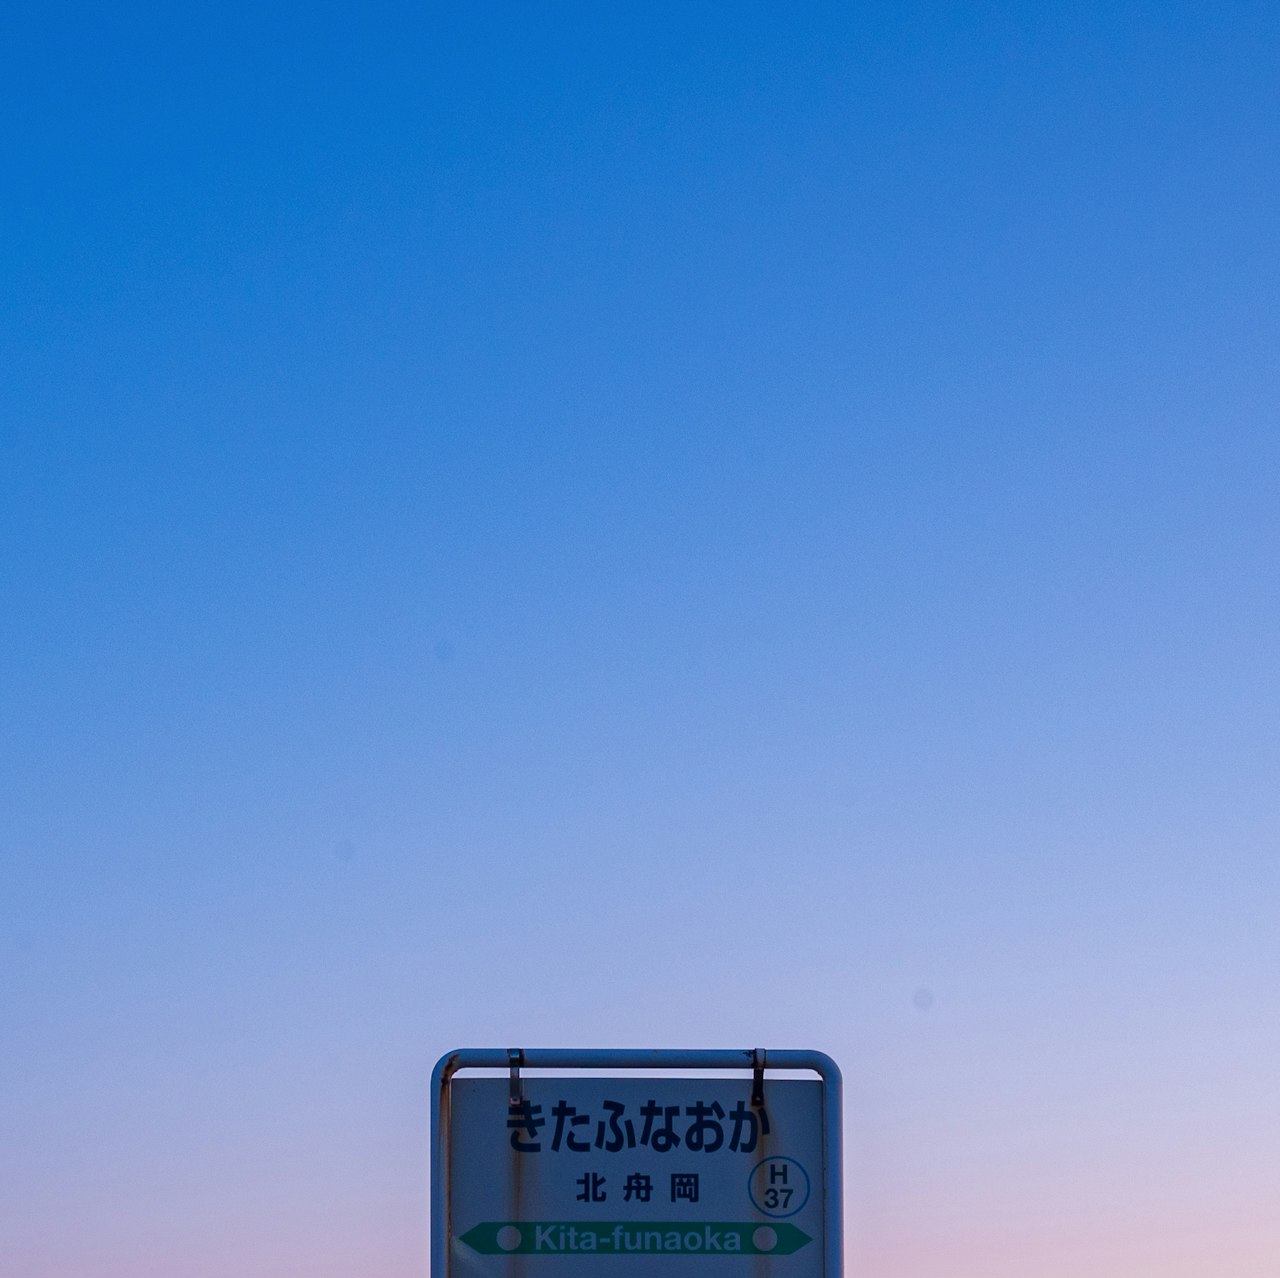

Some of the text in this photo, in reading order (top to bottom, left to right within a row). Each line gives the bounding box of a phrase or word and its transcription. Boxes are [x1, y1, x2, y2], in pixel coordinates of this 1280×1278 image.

[507, 1100, 770, 1152] きたふなおか
[770, 1164, 788, 1184] H
[576, 1172, 699, 1203] 北舟岡
[764, 1188, 793, 1209] 37
[535, 1226, 741, 1251] Kita-funaoka
